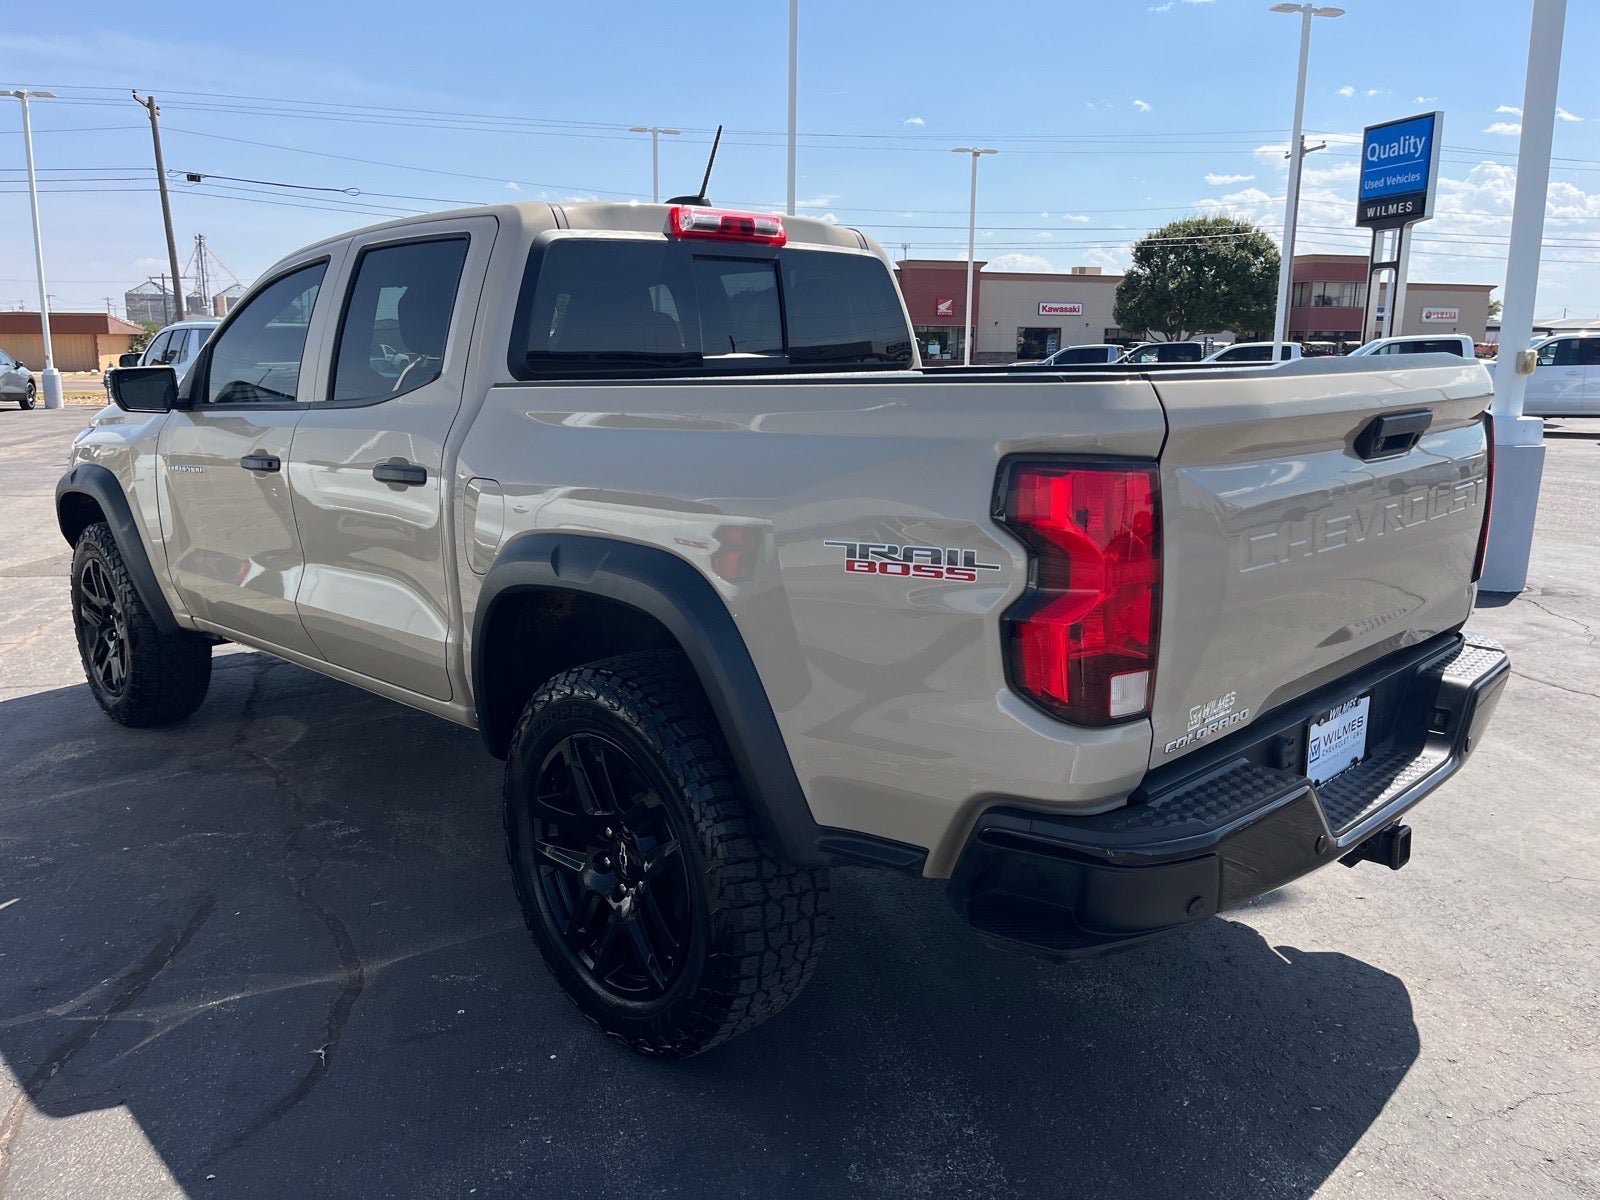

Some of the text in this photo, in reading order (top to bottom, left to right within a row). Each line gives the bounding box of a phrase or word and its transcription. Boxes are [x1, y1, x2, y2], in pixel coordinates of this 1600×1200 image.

[1367, 135, 1426, 162] Quality
[1364, 171, 1421, 190] Used Vehicles
[1366, 201, 1413, 218] WILMES
[1041, 304, 1080, 313] Kawasaki
[1239, 479, 1483, 573] CHEVROLET
[824, 540, 1000, 571] TRAIL
[845, 559, 977, 583] BOSS
[1202, 691, 1236, 717] WILMES
[1329, 697, 1358, 720] WILMES
[1164, 708, 1249, 754] COLORADO
[1323, 715, 1363, 746] WILMES
